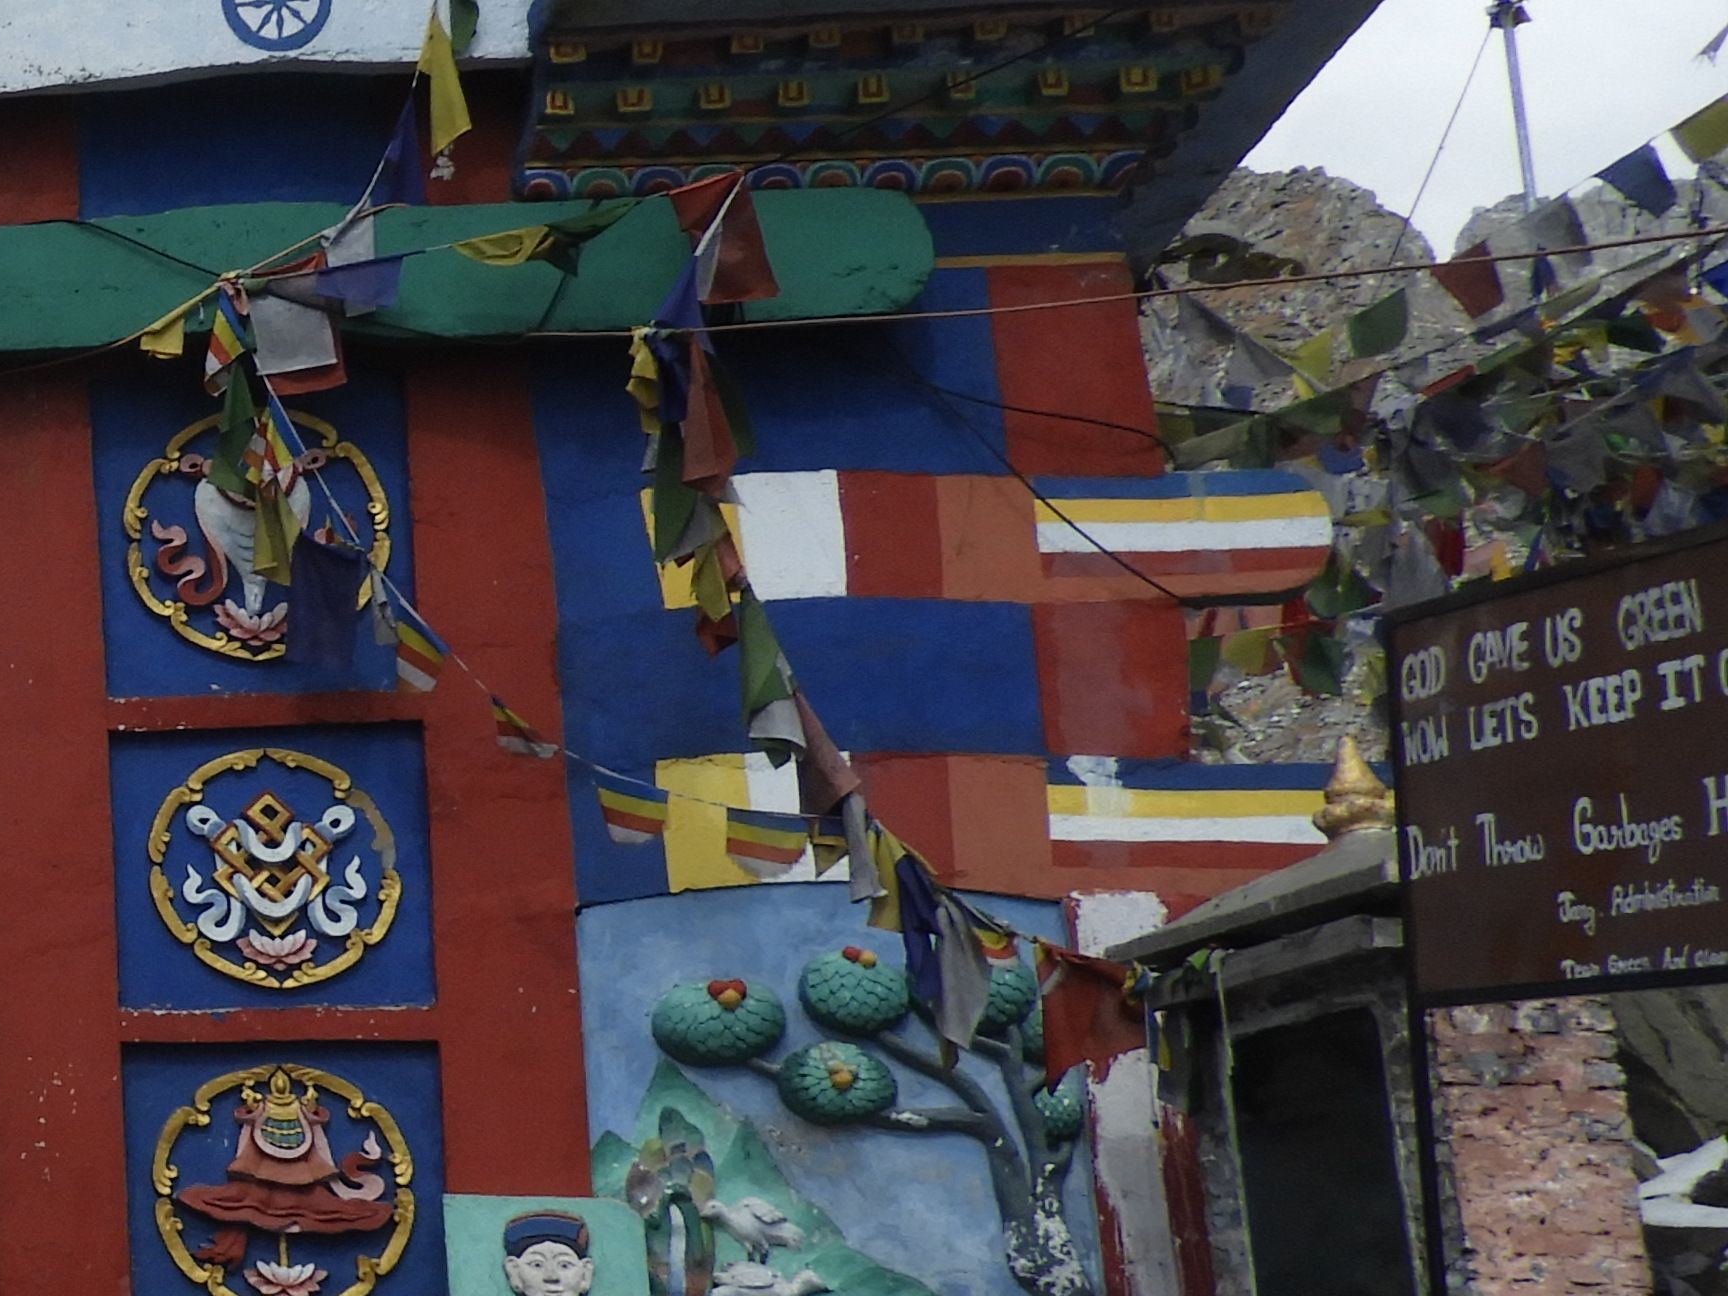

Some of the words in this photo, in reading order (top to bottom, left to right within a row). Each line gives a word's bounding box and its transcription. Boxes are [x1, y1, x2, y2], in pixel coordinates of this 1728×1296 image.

[1401, 645, 1446, 702] GOD
[1467, 621, 1531, 684] GAVE
[1545, 607, 1583, 668] US
[1617, 578, 1702, 650] GREEN
[1469, 691, 1539, 751] LETS
[1562, 669, 1642, 731] KEEP
[1657, 654, 1706, 711] IT
[1476, 813, 1544, 867] Throw
[1573, 792, 1683, 864] Garbages
